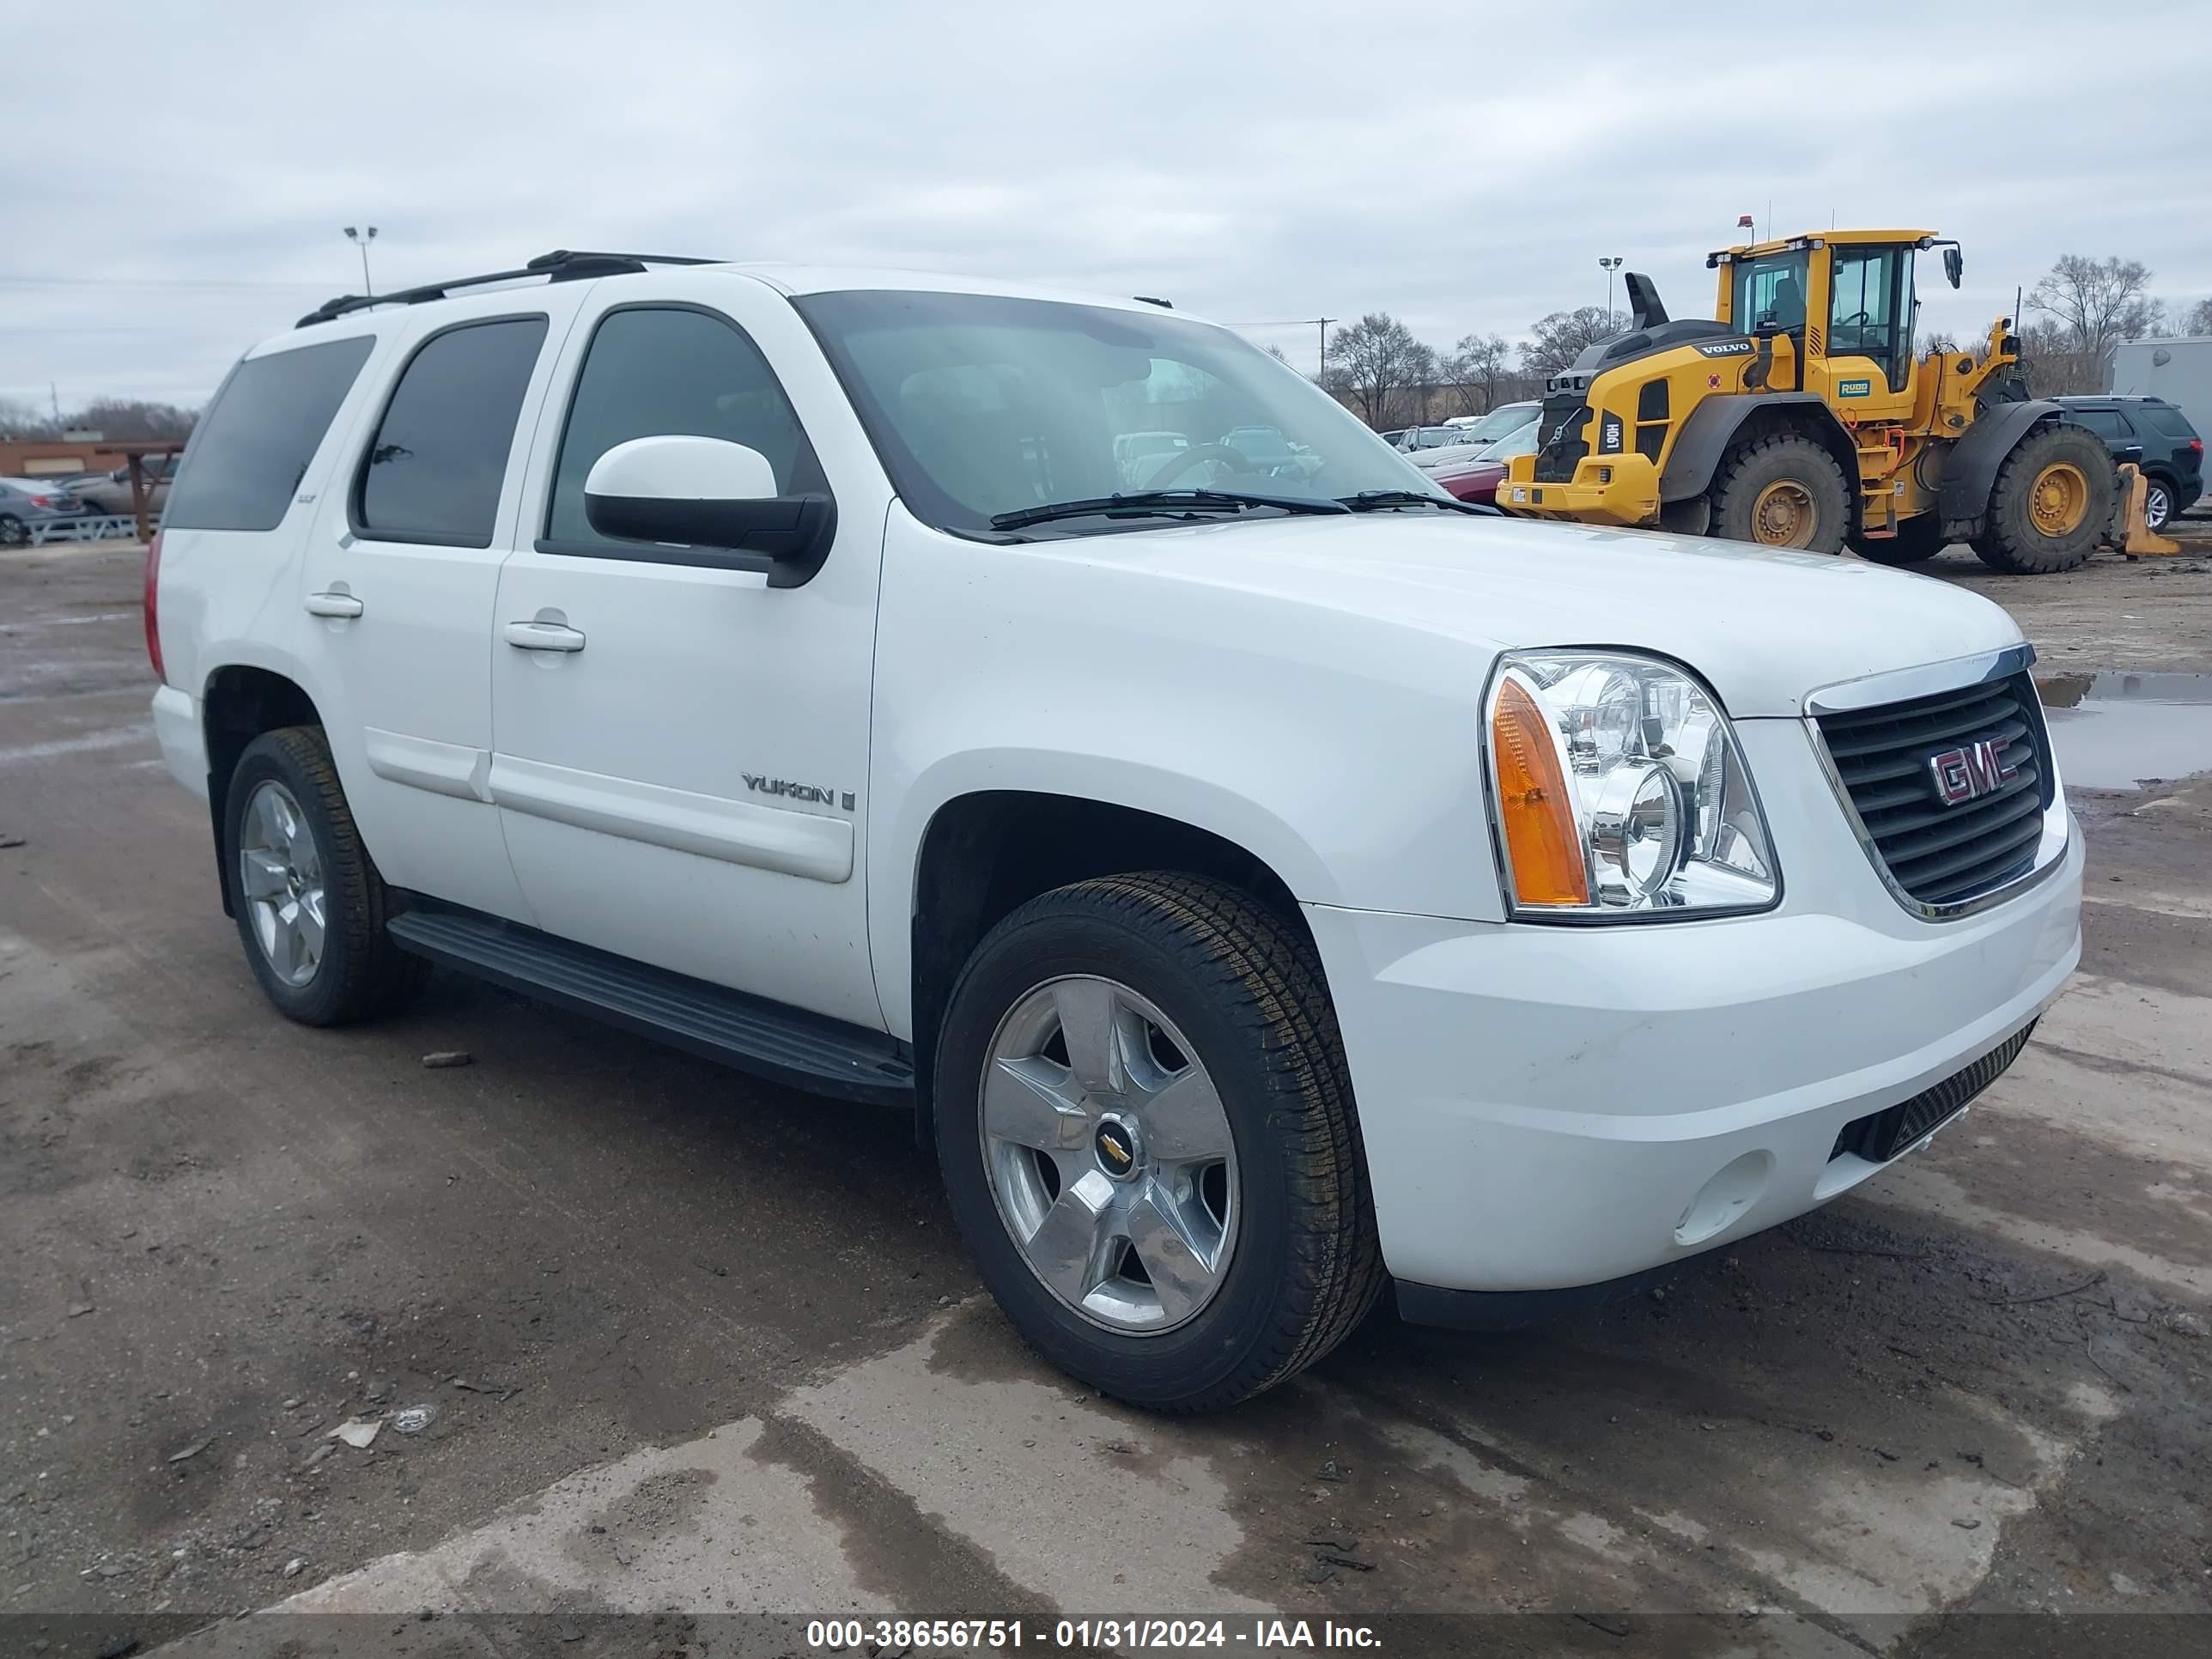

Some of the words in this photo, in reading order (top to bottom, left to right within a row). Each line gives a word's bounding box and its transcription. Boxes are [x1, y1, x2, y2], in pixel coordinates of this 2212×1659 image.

[1702, 343, 1749, 354] VOLVO
[1606, 423, 1620, 449] L90H
[1930, 735, 2019, 806] GMC
[741, 771, 834, 806] YUKON
